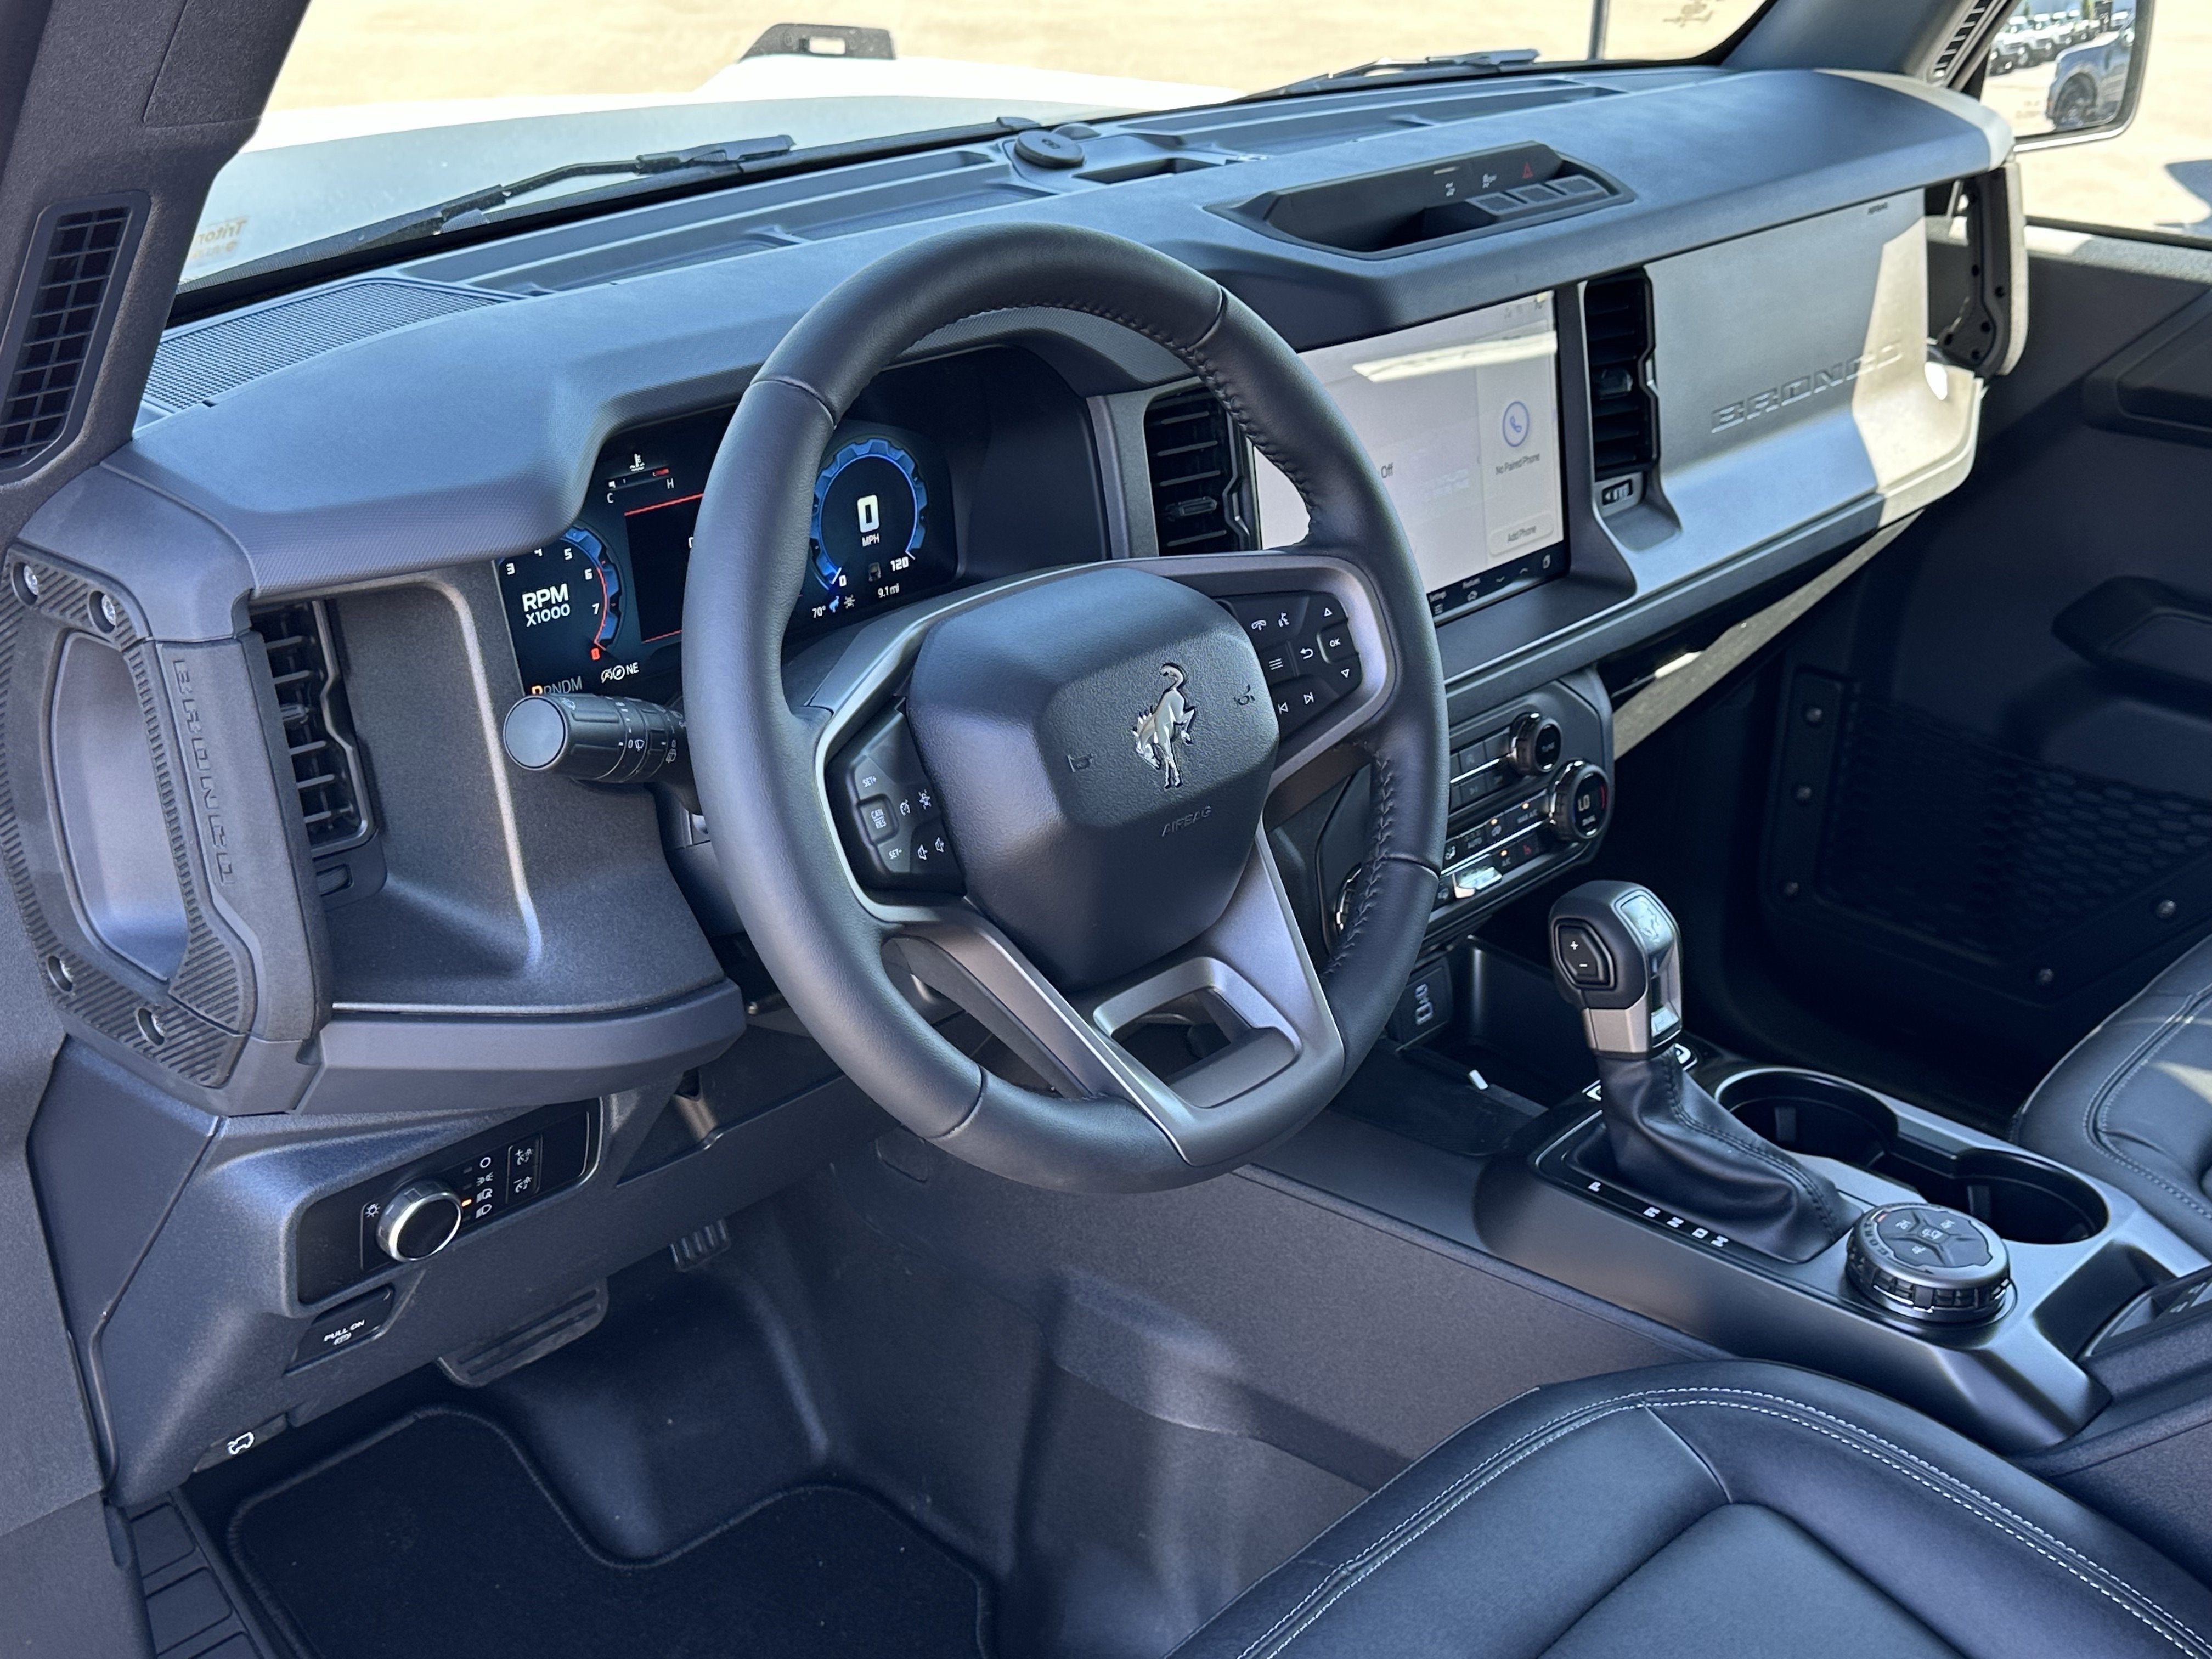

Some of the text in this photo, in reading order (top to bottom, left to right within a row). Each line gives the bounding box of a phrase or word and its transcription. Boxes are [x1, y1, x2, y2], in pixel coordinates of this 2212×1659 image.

[1711, 341, 1904, 434] BRONCO
[666, 478, 674, 489] H
[607, 493, 614, 504] C
[857, 494, 880, 533] 0
[861, 533, 880, 548] MPH
[563, 548, 573, 560] 5
[506, 562, 516, 575] 3
[890, 556, 910, 572] 120
[584, 568, 593, 580] 6
[839, 574, 847, 588] 0
[522, 583, 569, 612] RPM
[525, 603, 571, 627] X1000
[592, 602, 600, 615] 7
[1329, 637, 1341, 647] OK
[625, 662, 640, 675] NE
[172, 659, 236, 886] BRONCO
[1161, 805, 1211, 837] AIRBAG
[1588, 1181, 1601, 1192] P
[324, 1319, 365, 1341] PULL ON
